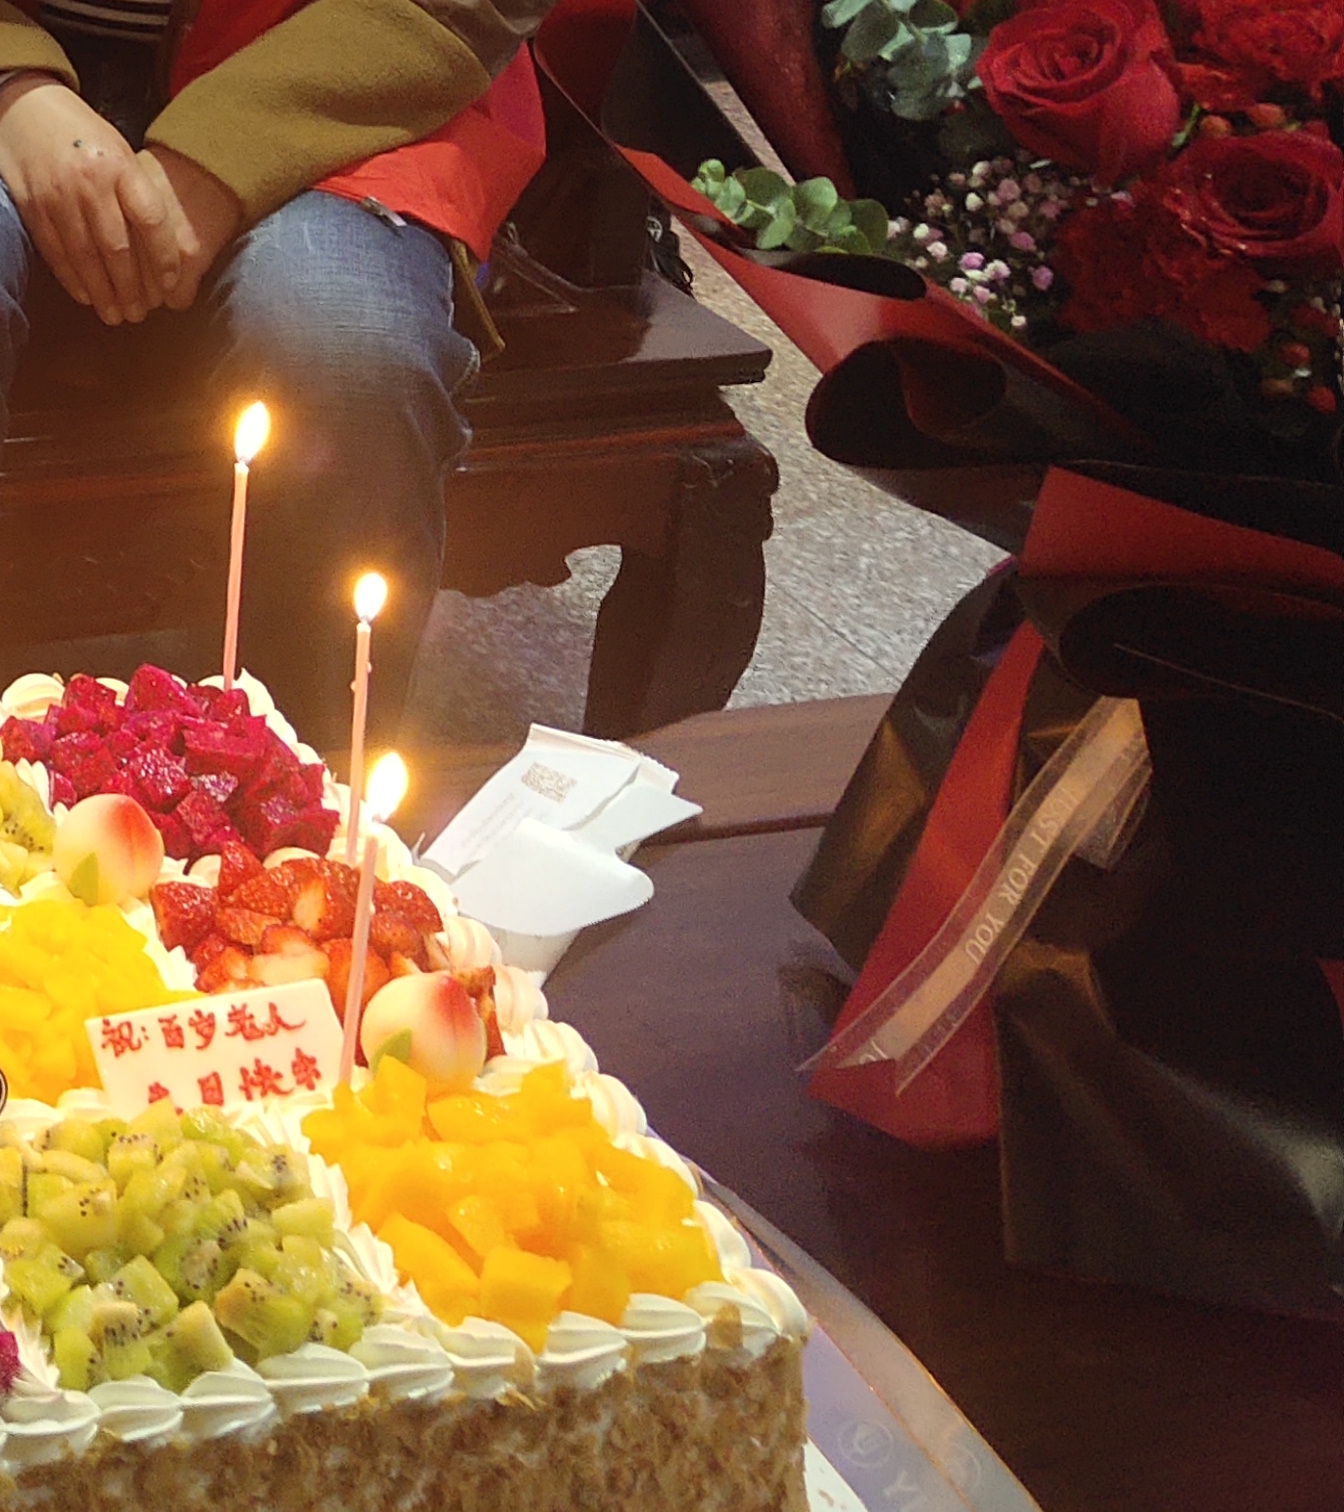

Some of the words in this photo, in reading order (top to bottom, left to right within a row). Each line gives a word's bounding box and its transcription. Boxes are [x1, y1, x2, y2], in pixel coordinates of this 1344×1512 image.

[1030, 787, 1079, 855] JUST
[998, 853, 1040, 907] FOR
[965, 913, 1006, 965] YOU
